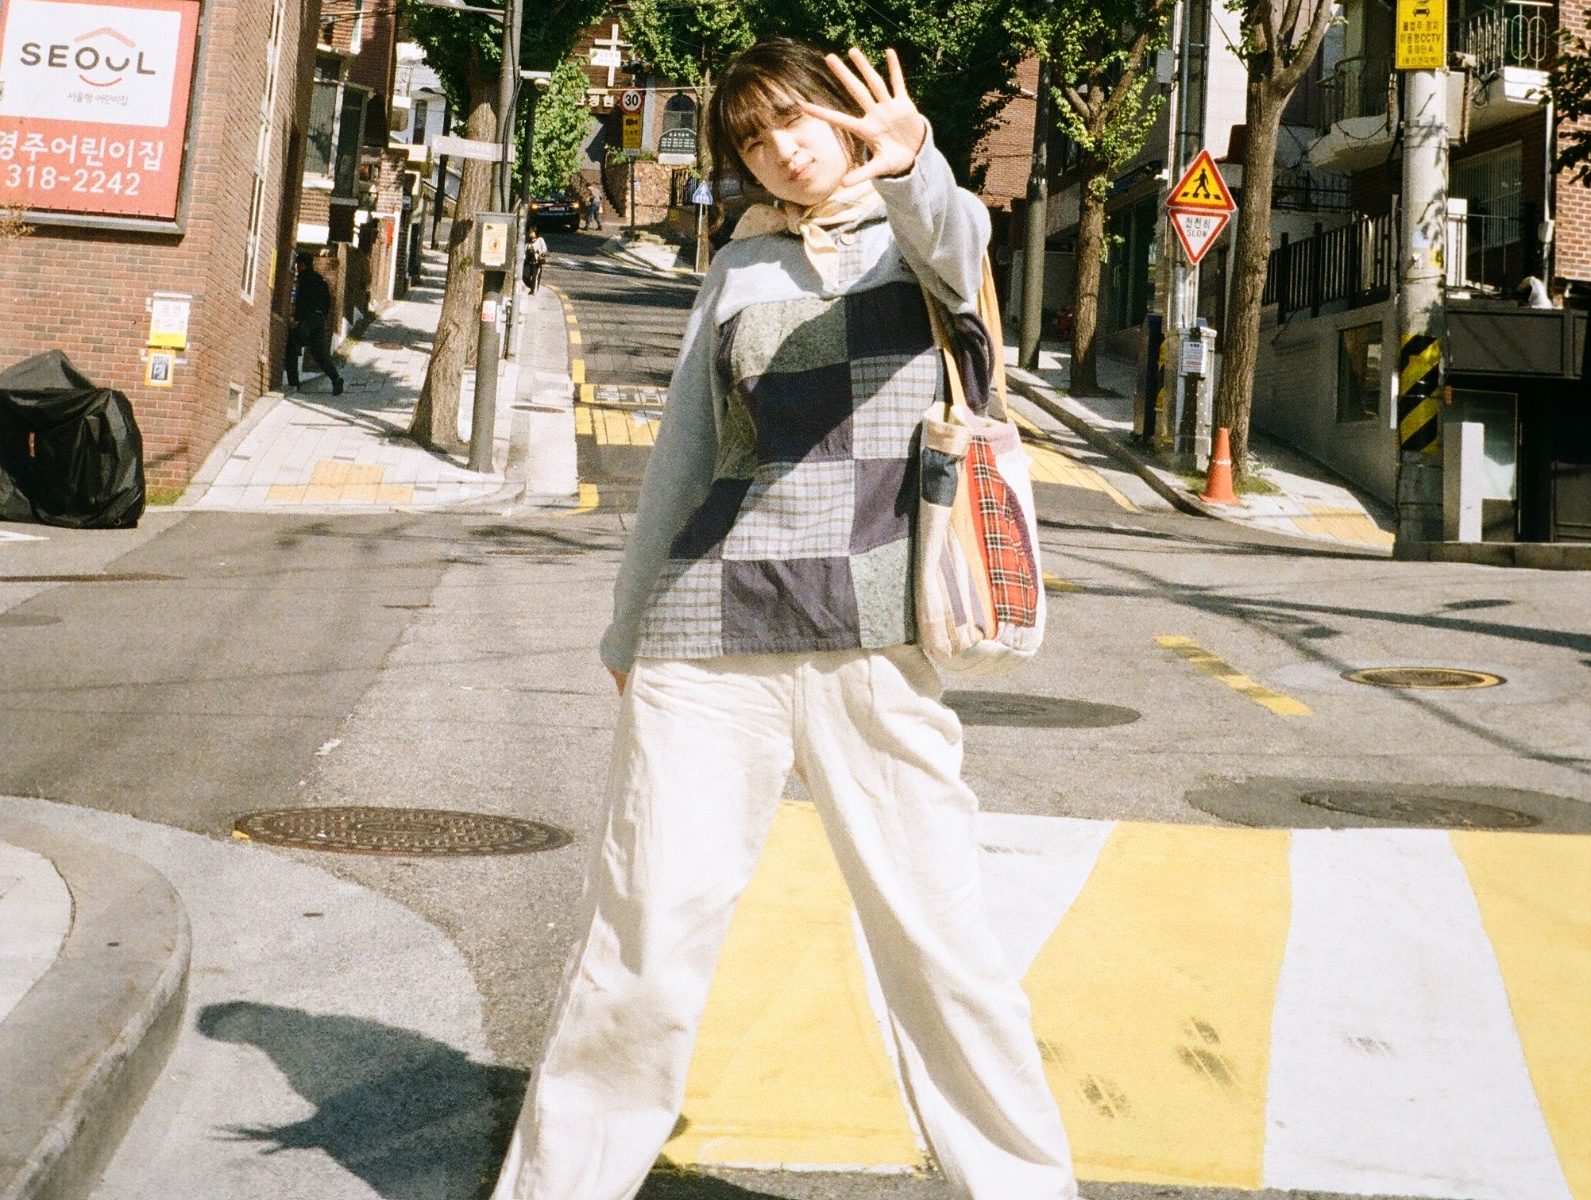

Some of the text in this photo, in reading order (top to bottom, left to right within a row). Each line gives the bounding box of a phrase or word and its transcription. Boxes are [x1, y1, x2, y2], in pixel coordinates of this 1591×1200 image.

[20, 42, 156, 75] SEOUL
[625, 94, 639, 106] 30
[5, 163, 141, 196] 318-2242
[1185, 217, 1211, 230] 천천히
[1187, 230, 1207, 238] SLOW
